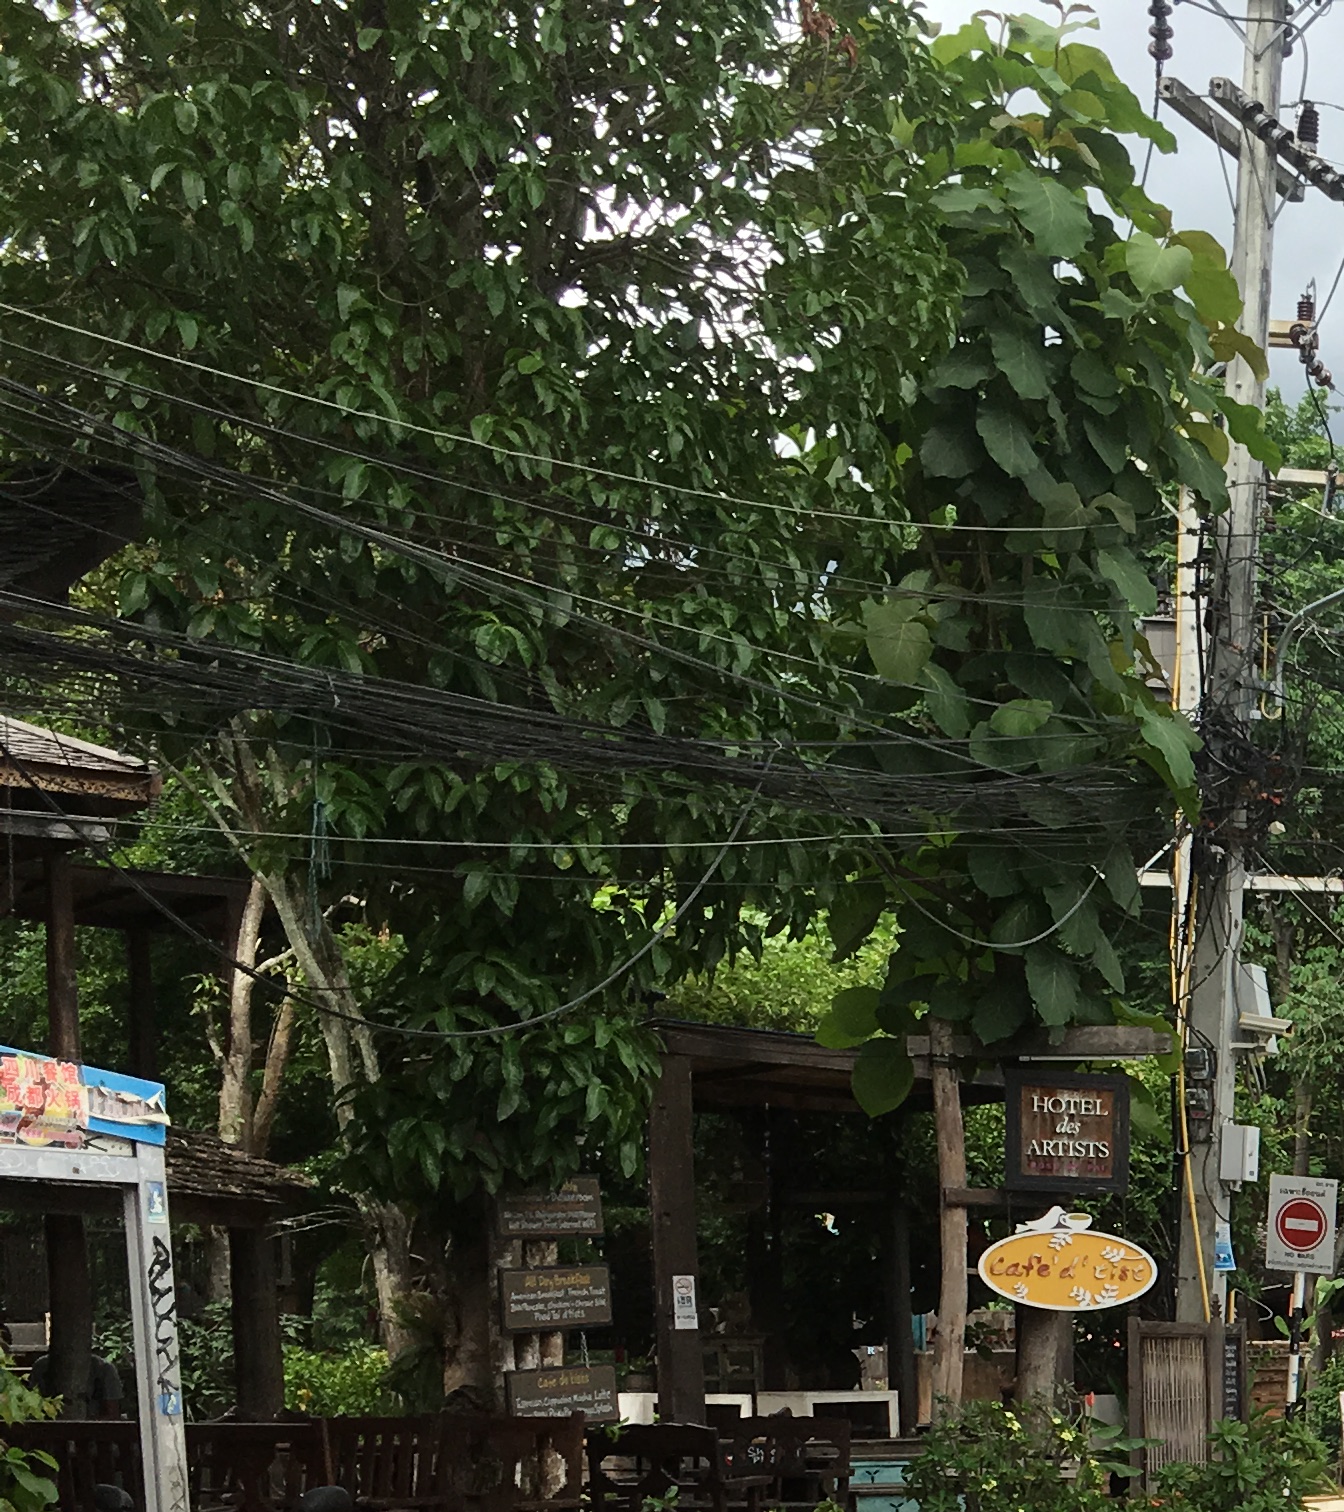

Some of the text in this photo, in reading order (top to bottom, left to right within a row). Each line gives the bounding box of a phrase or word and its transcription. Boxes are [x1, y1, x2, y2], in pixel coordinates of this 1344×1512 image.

[1031, 1095, 1109, 1116] HOTEL
[1056, 1116, 1081, 1134] des
[1026, 1140, 1110, 1158] ARTISTS
